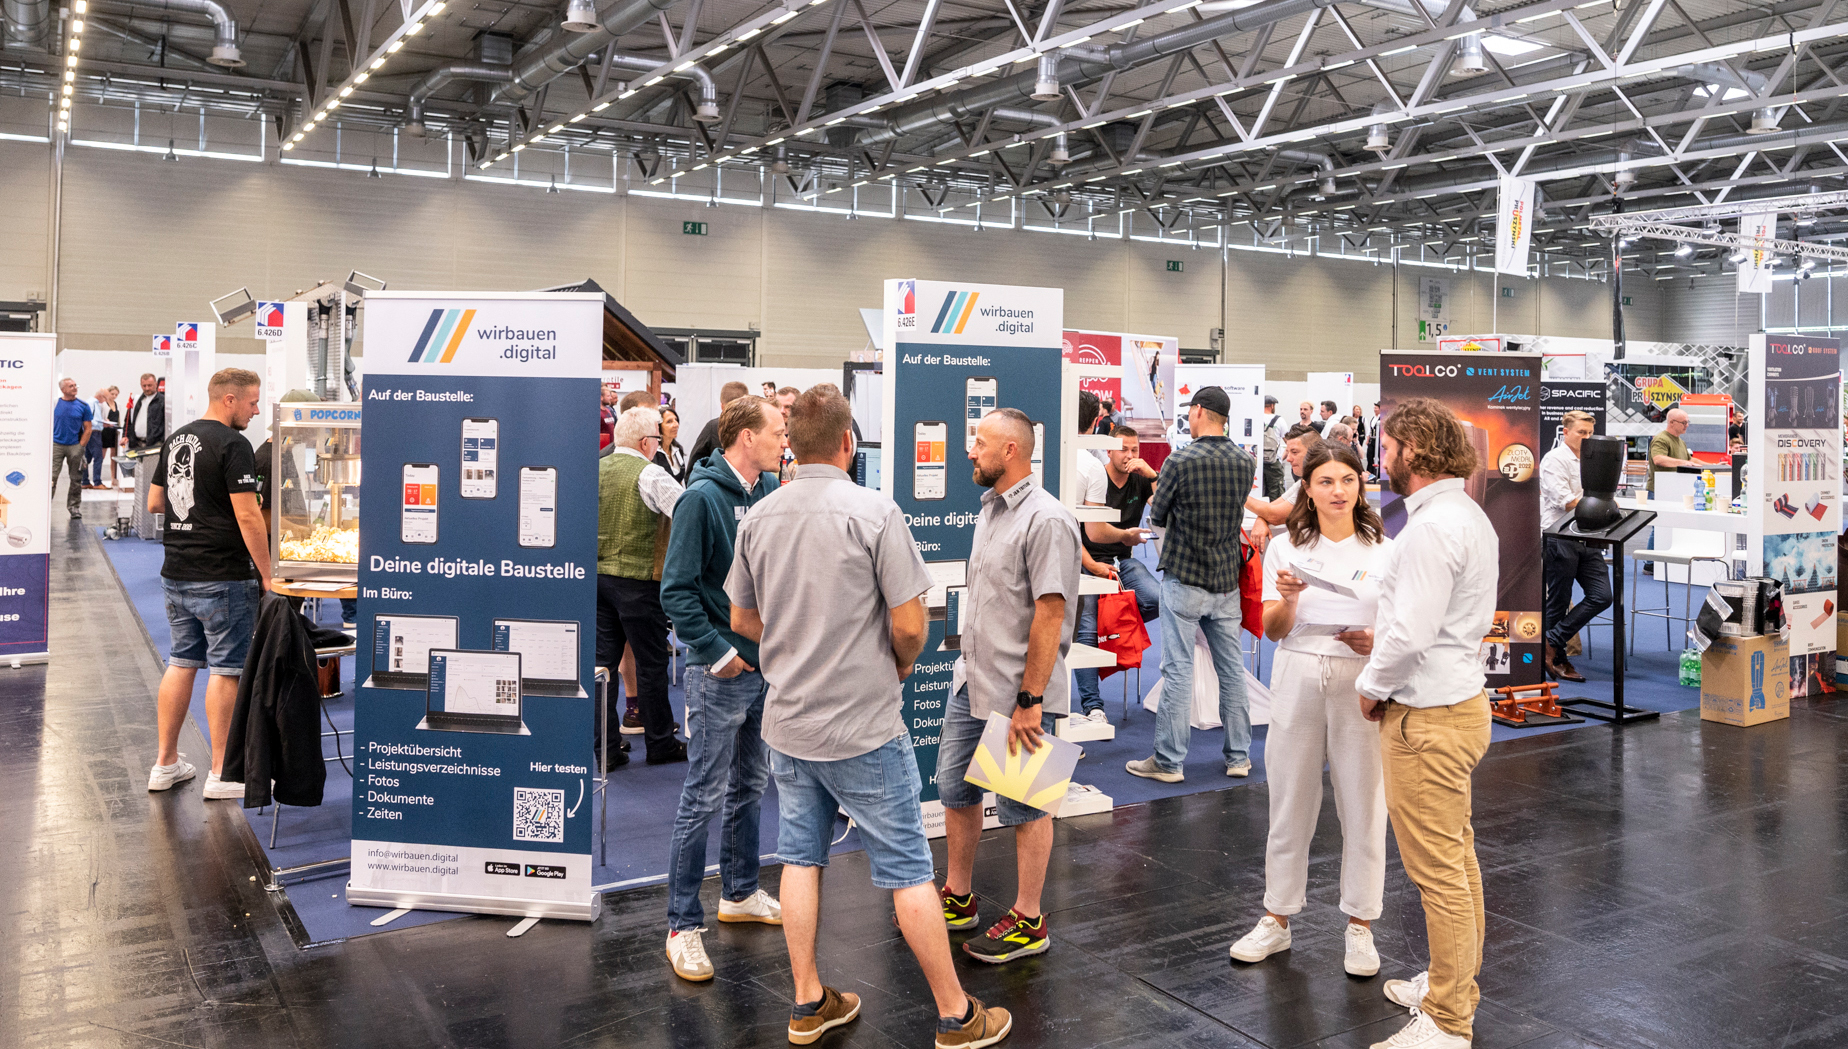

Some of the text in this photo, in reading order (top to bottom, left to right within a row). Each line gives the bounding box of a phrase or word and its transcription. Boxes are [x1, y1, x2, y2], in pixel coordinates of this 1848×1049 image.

[980, 305, 1034, 319] wirbauen
[898, 316, 915, 327] 6.426E
[995, 320, 1033, 335] .digital
[478, 326, 556, 340] wirbauen
[499, 344, 556, 362] .digital
[902, 354, 991, 366] Auf der Baustelle:
[1635, 378, 1664, 388] GRUPA
[368, 389, 474, 402] Auf der Baustelle:
[1488, 385, 1531, 402] AirJet
[1552, 390, 1601, 398] SPACIFIC
[310, 410, 361, 420] POPCORN
[1778, 439, 1826, 448] DISCOVERY
[904, 514, 940, 527] Deine
[370, 555, 585, 579] Deine digitale Baustelle
[363, 587, 413, 599] Im Büro:
[914, 700, 941, 710] Fotos
[369, 741, 462, 758] Projektübersicht
[368, 758, 501, 776] Leistungsverzeichnisse
[530, 762, 587, 774] Hier testen
[368, 775, 400, 787] Fotos
[368, 791, 434, 805] Dokumente
[367, 807, 403, 820] Zeiten
[368, 849, 458, 863] info@wirbauen.digital
[368, 863, 458, 876] www.wirbauen.digital
